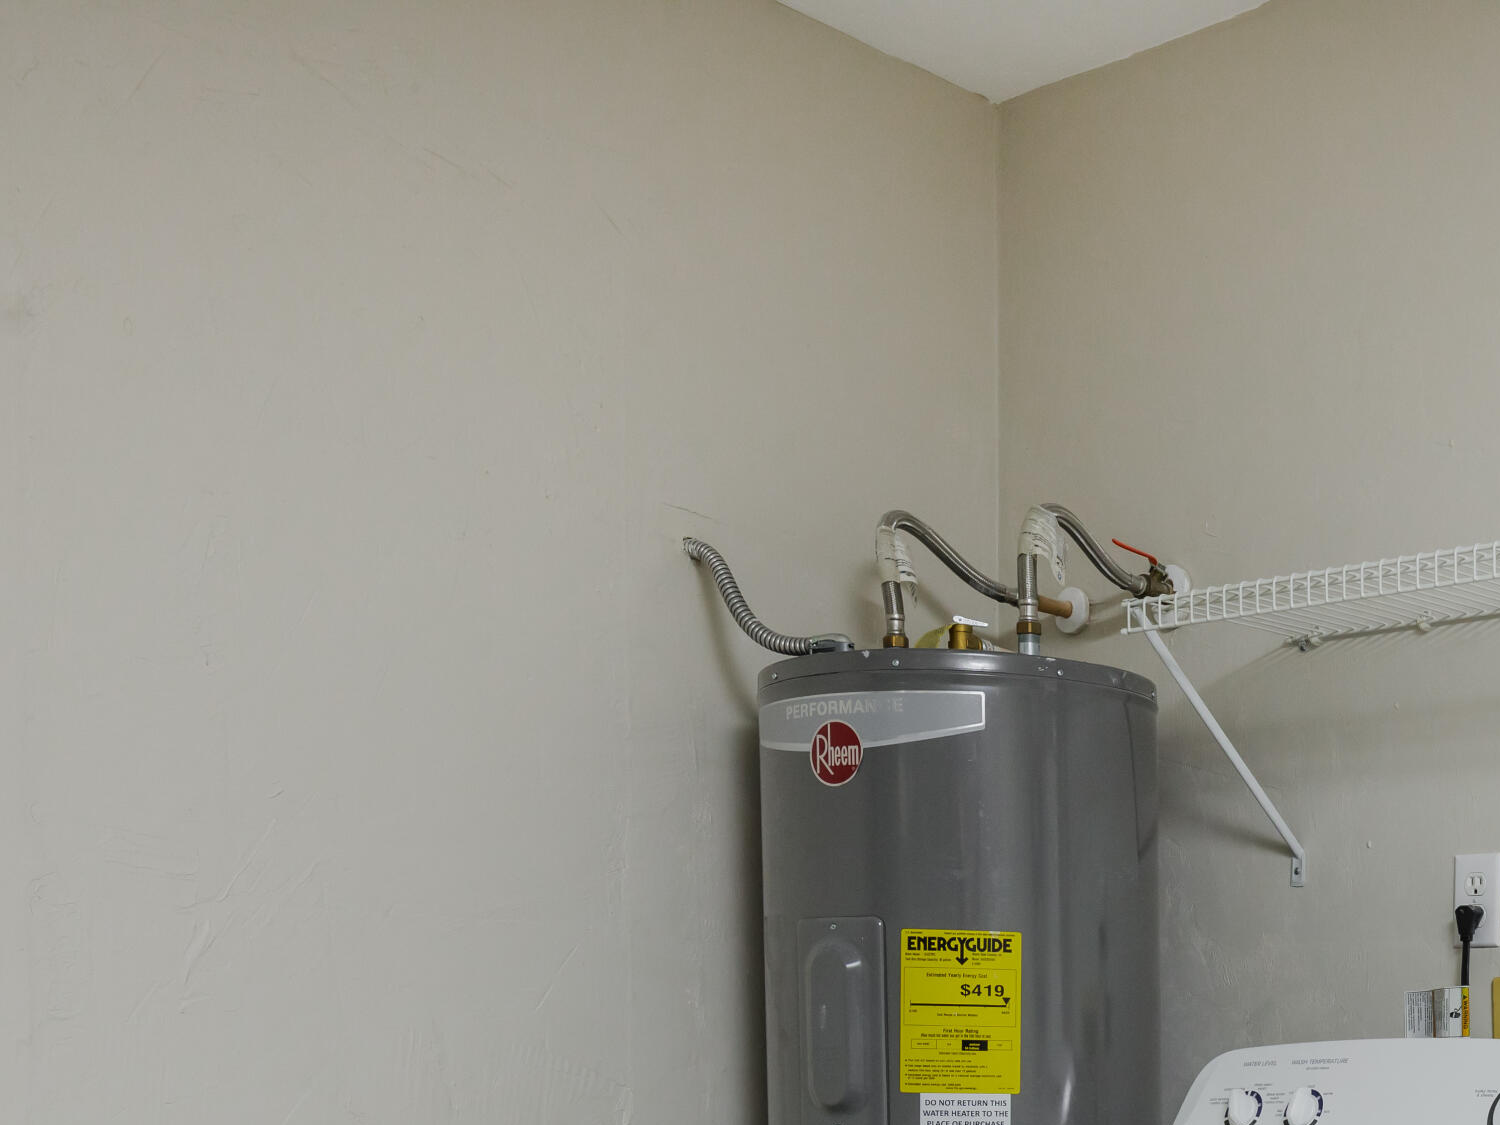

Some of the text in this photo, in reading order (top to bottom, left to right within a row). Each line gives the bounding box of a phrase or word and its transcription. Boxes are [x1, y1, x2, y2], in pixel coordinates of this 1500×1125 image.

[785, 697, 904, 720] PERFORMANE
[816, 723, 860, 775] Rheem
[907, 936, 1012, 954] ENERGYGUIDE
[960, 984, 1005, 998] $419
[925, 1099, 1007, 1107] DO NOT RETURN THIS
[922, 1110, 1009, 1118] WATER HEATER TO THE
